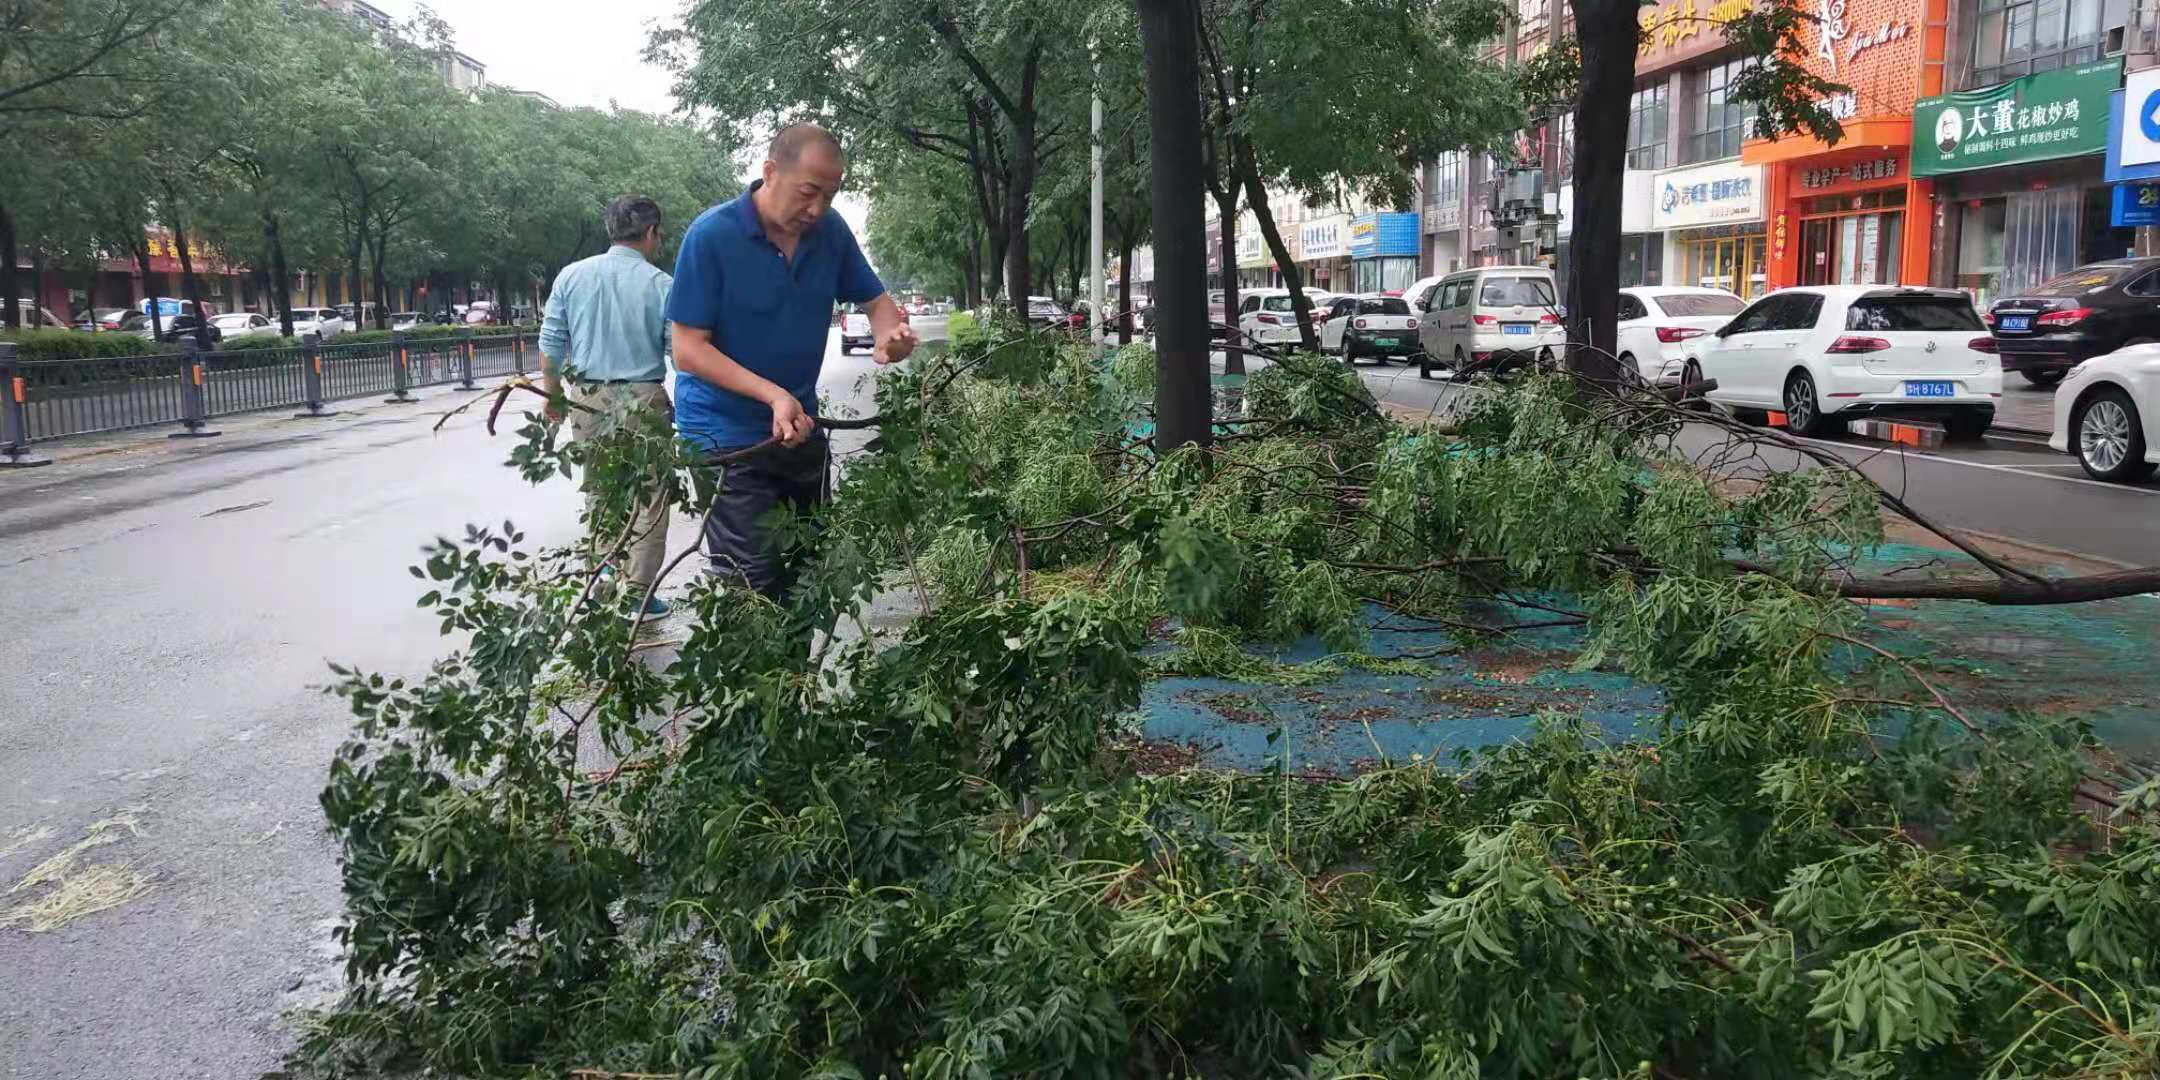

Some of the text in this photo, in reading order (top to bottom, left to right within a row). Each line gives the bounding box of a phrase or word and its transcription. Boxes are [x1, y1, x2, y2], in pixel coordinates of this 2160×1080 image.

[1965, 98, 2081, 140] 大董 花椒炒鸡
